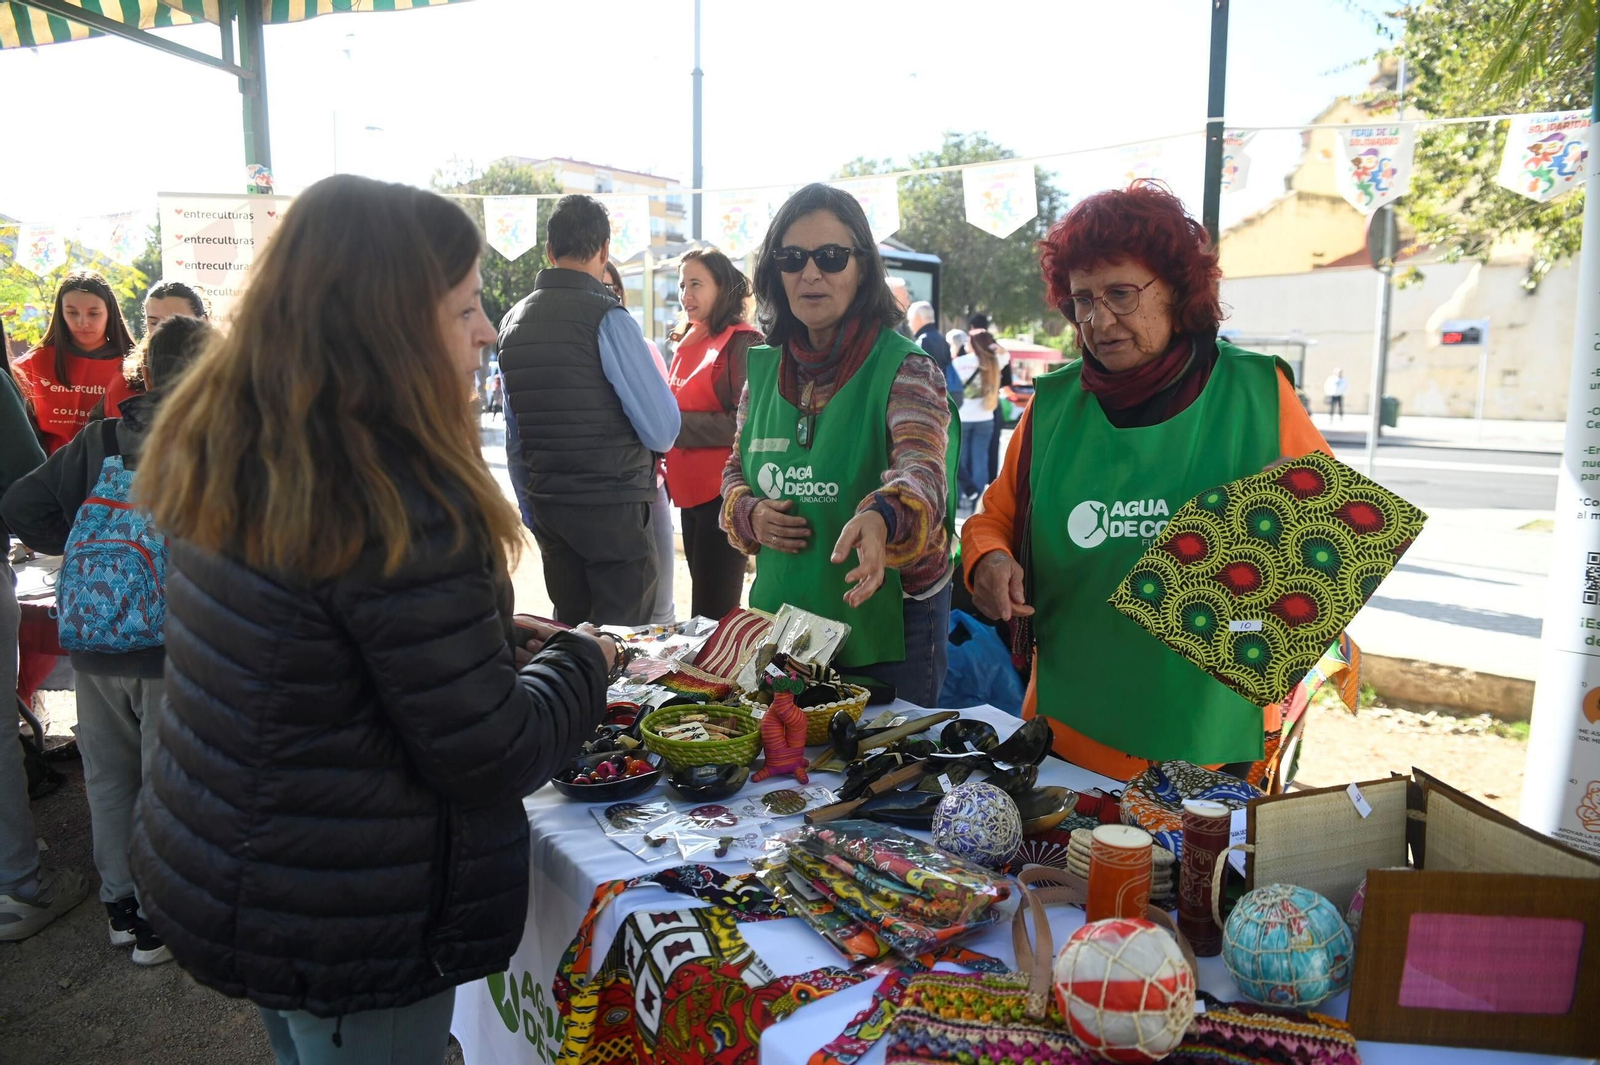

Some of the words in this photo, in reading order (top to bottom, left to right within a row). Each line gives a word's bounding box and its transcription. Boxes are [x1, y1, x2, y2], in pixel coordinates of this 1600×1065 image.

[183, 210, 254, 220] entreculturas
[184, 235, 254, 245] entreculturas
[1110, 499, 1170, 517] AGUA
[1110, 520, 1138, 537] DE
